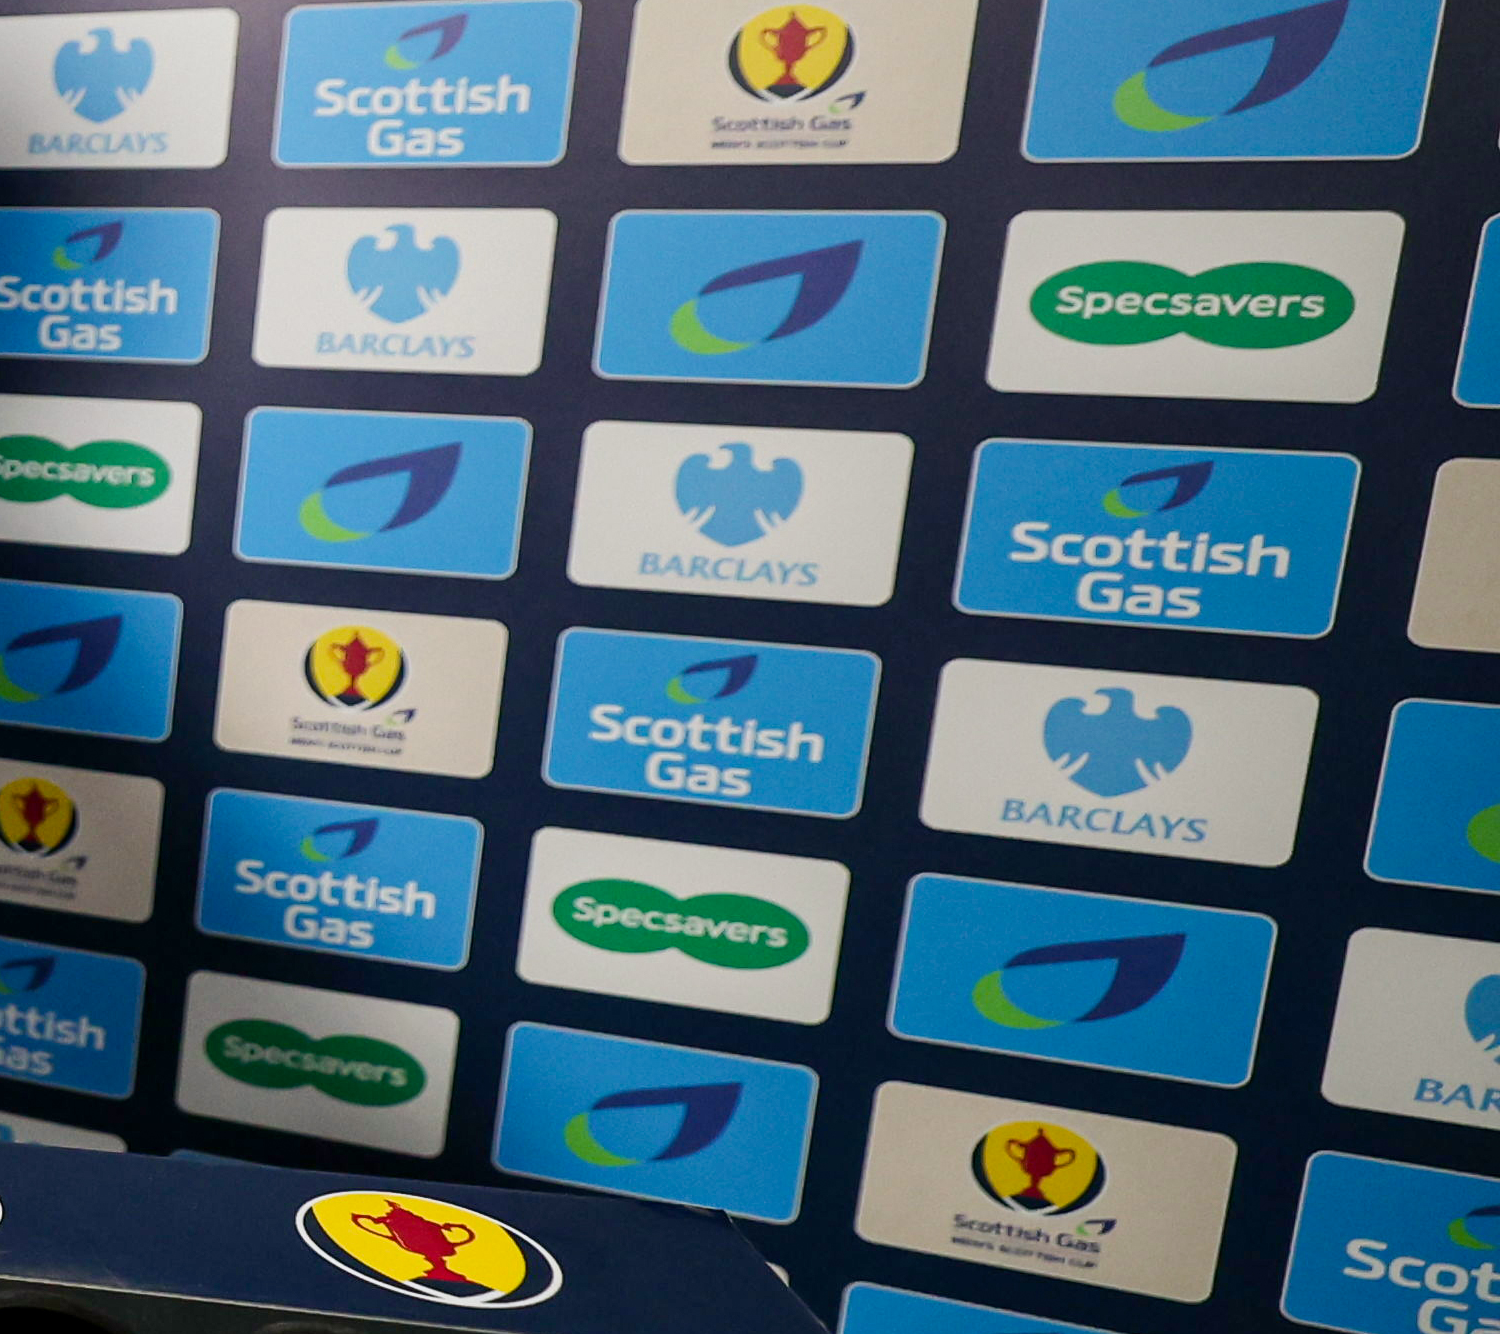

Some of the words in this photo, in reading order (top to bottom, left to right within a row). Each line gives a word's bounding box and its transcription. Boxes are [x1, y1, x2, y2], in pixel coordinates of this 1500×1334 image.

[313, 73, 530, 119] Scottish
[27, 132, 168, 157] BARCLAYS
[366, 118, 465, 157] Gas
[711, 115, 805, 133] Scottish
[810, 113, 852, 131] Gas
[1054, 285, 1326, 322] Specsavers
[37, 314, 122, 353] Gas
[315, 331, 476, 359] BARCLAYS
[637, 551, 820, 587] BARCLAYS
[1008, 520, 1290, 579] Scottish
[1075, 572, 1202, 619] Gas
[589, 706, 824, 764] Scottish
[643, 753, 752, 798] Gas
[999, 799, 1208, 844] BARCLAYS
[234, 858, 437, 920] Scottish
[283, 904, 376, 950] Gas
[572, 895, 790, 949] Specsavers
[223, 1034, 409, 1091] Specsavers
[953, 1213, 1050, 1244] Scottish
[1056, 1232, 1102, 1253] Gas
[1343, 1238, 1500, 1305] Scot
